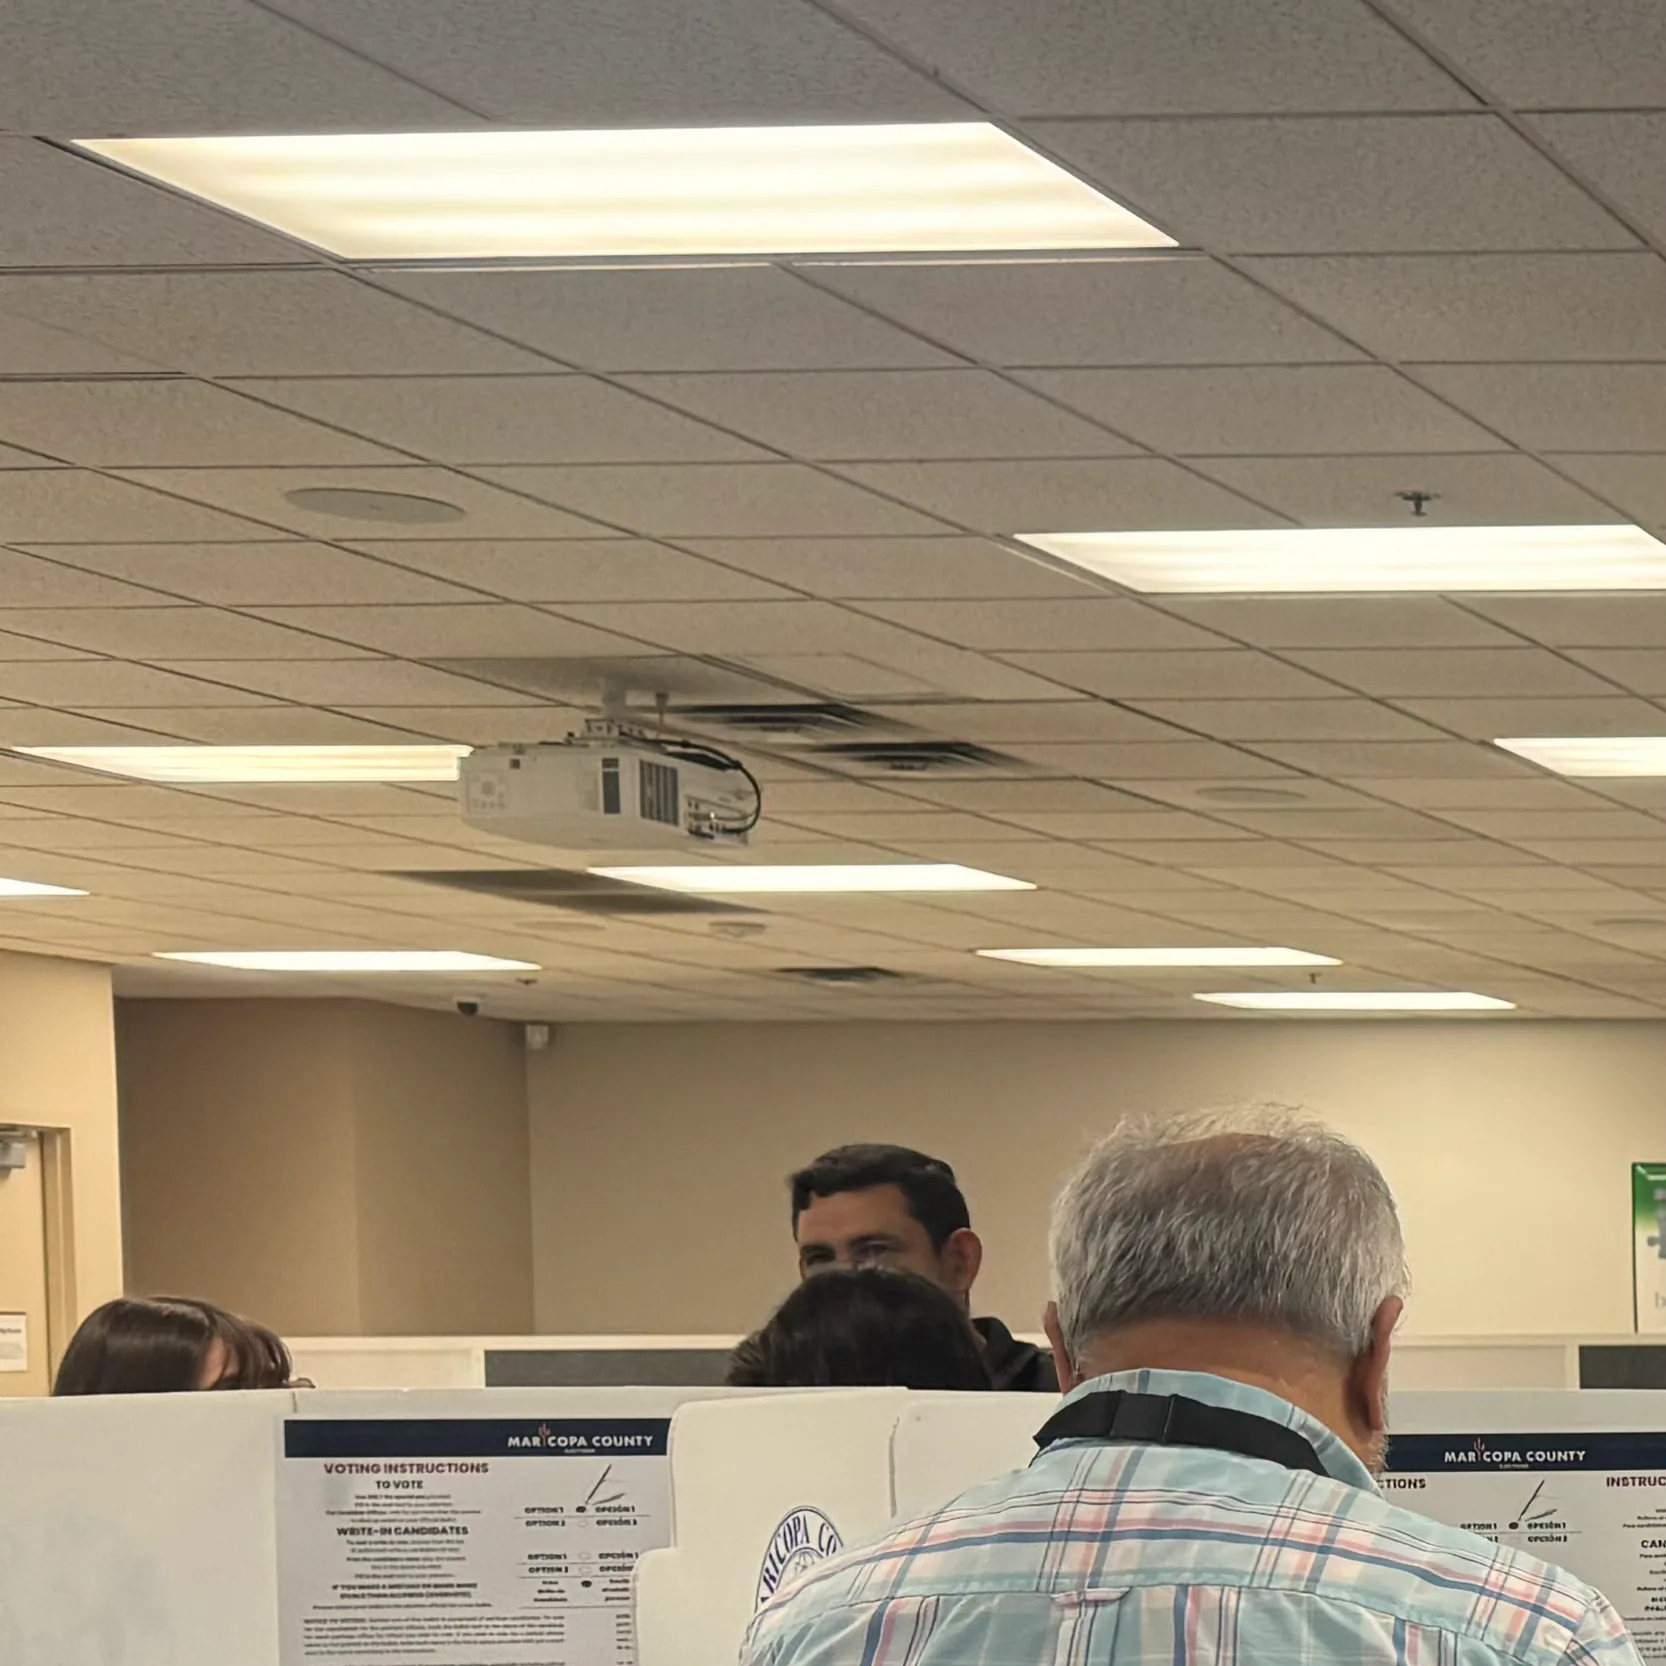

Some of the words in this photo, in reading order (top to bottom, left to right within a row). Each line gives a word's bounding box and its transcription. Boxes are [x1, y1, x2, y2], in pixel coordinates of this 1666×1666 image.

[507, 1430, 588, 1448] MARICOPA
[591, 1435, 654, 1448] COUNTY
[1444, 1444, 1521, 1463] MARICOPA
[1526, 1450, 1587, 1463] COUNTY
[323, 1462, 382, 1475] VOTING
[383, 1461, 490, 1474] INSTRUCTIONS
[375, 1480, 391, 1490] TO
[392, 1479, 424, 1490] VOTE
[336, 1526, 393, 1536] WRITE-IN
[394, 1525, 469, 1536] CANDIDATES
